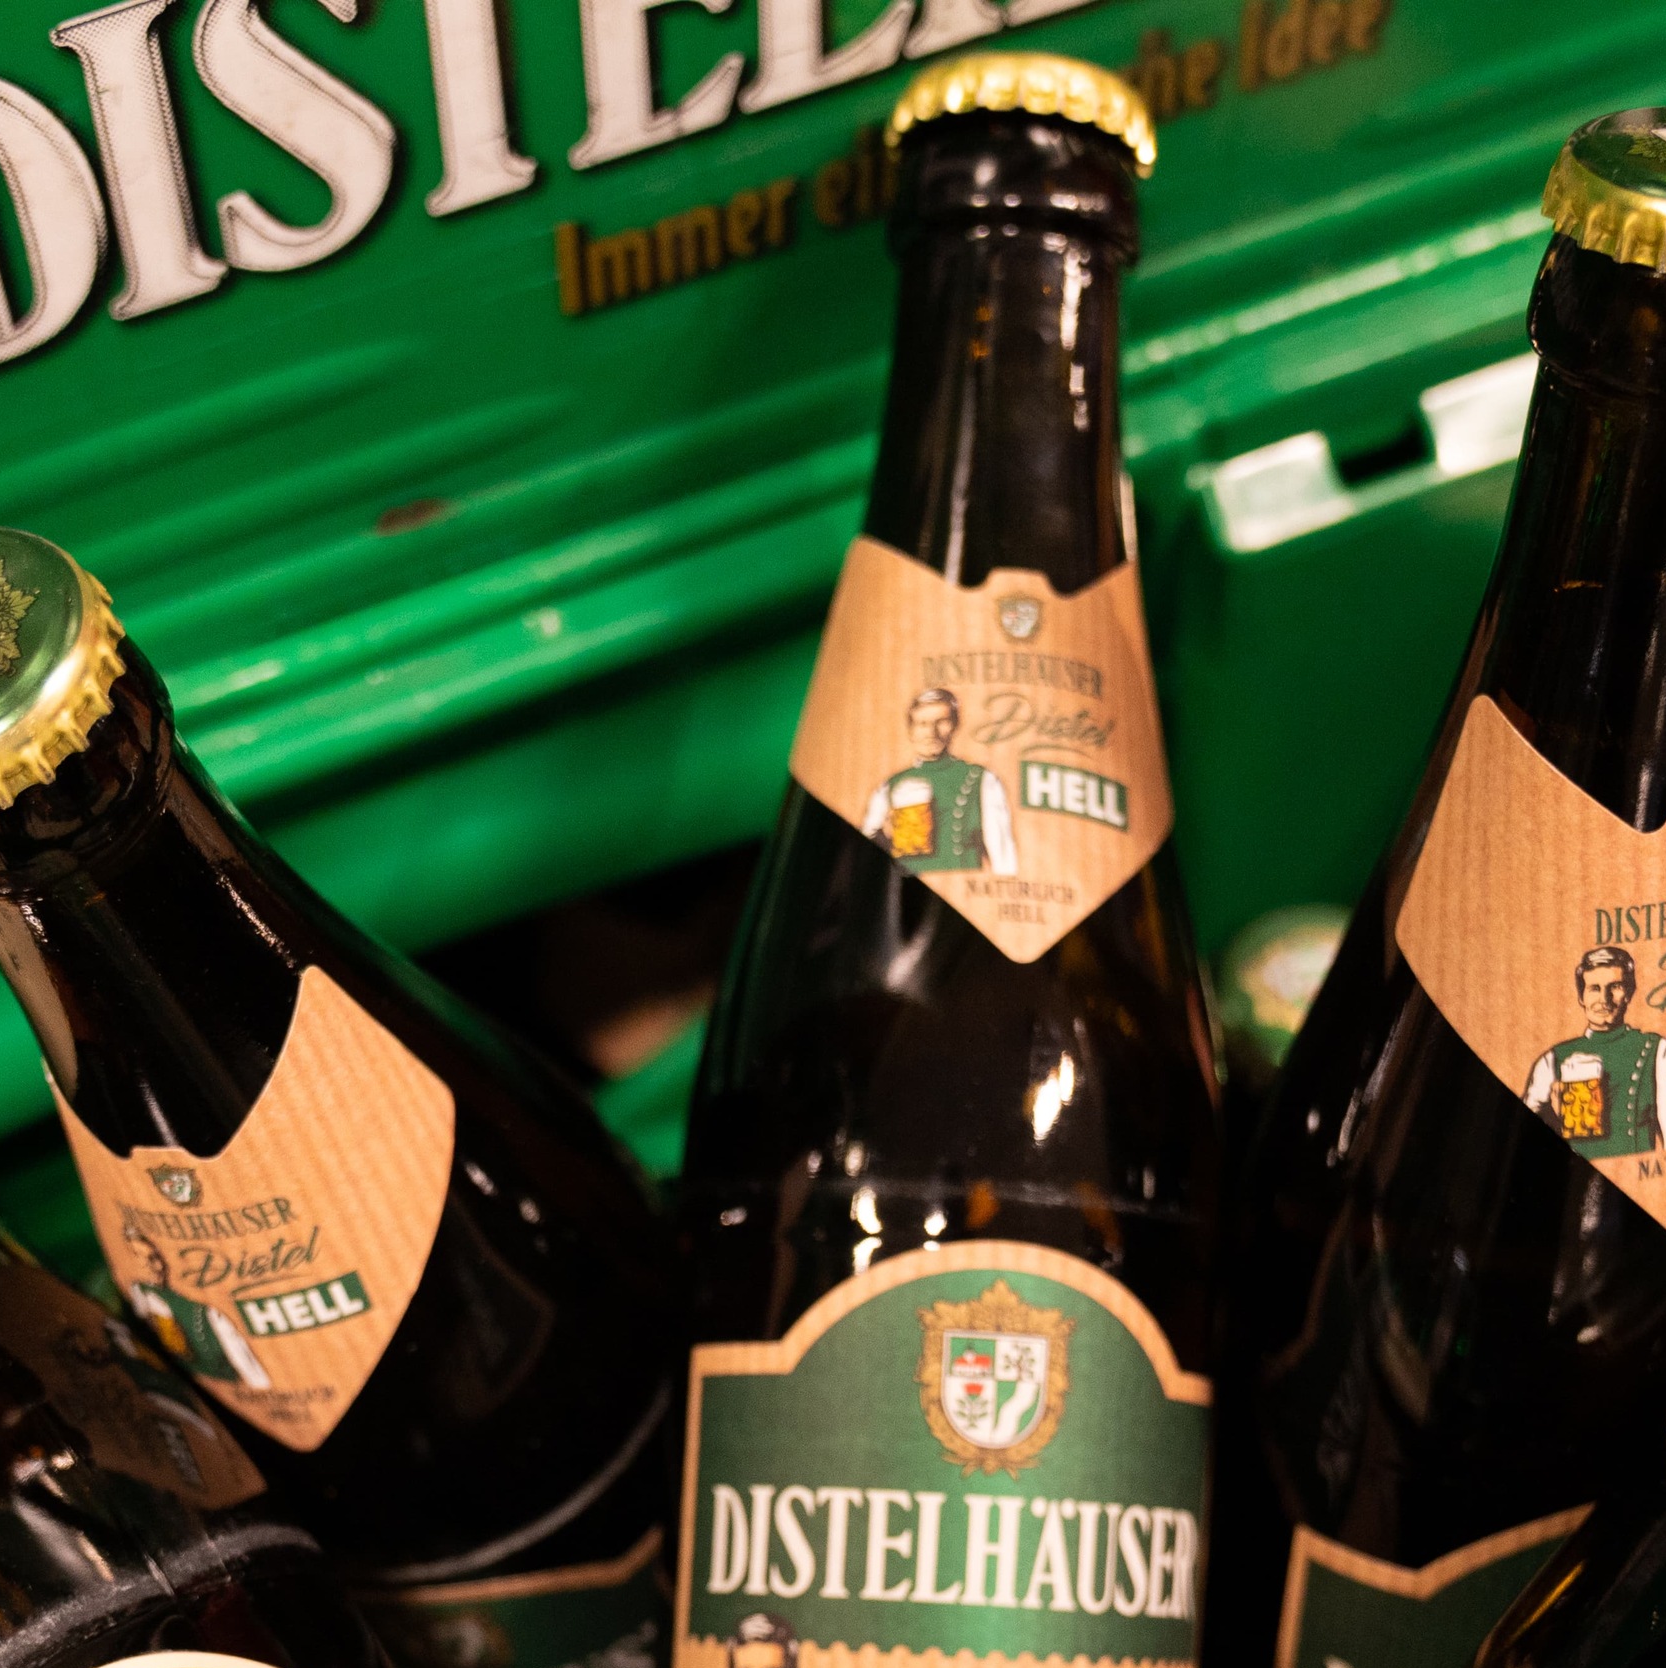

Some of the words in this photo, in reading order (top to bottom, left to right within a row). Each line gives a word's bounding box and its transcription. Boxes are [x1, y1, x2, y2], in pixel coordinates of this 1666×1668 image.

[553, 174, 795, 318] Immer
[1025, 763, 1126, 827] HELL
[179, 1225, 320, 1289] Distel
[242, 1280, 365, 1335] HELL
[705, 1482, 1199, 1621] DISTELHÄUSER
